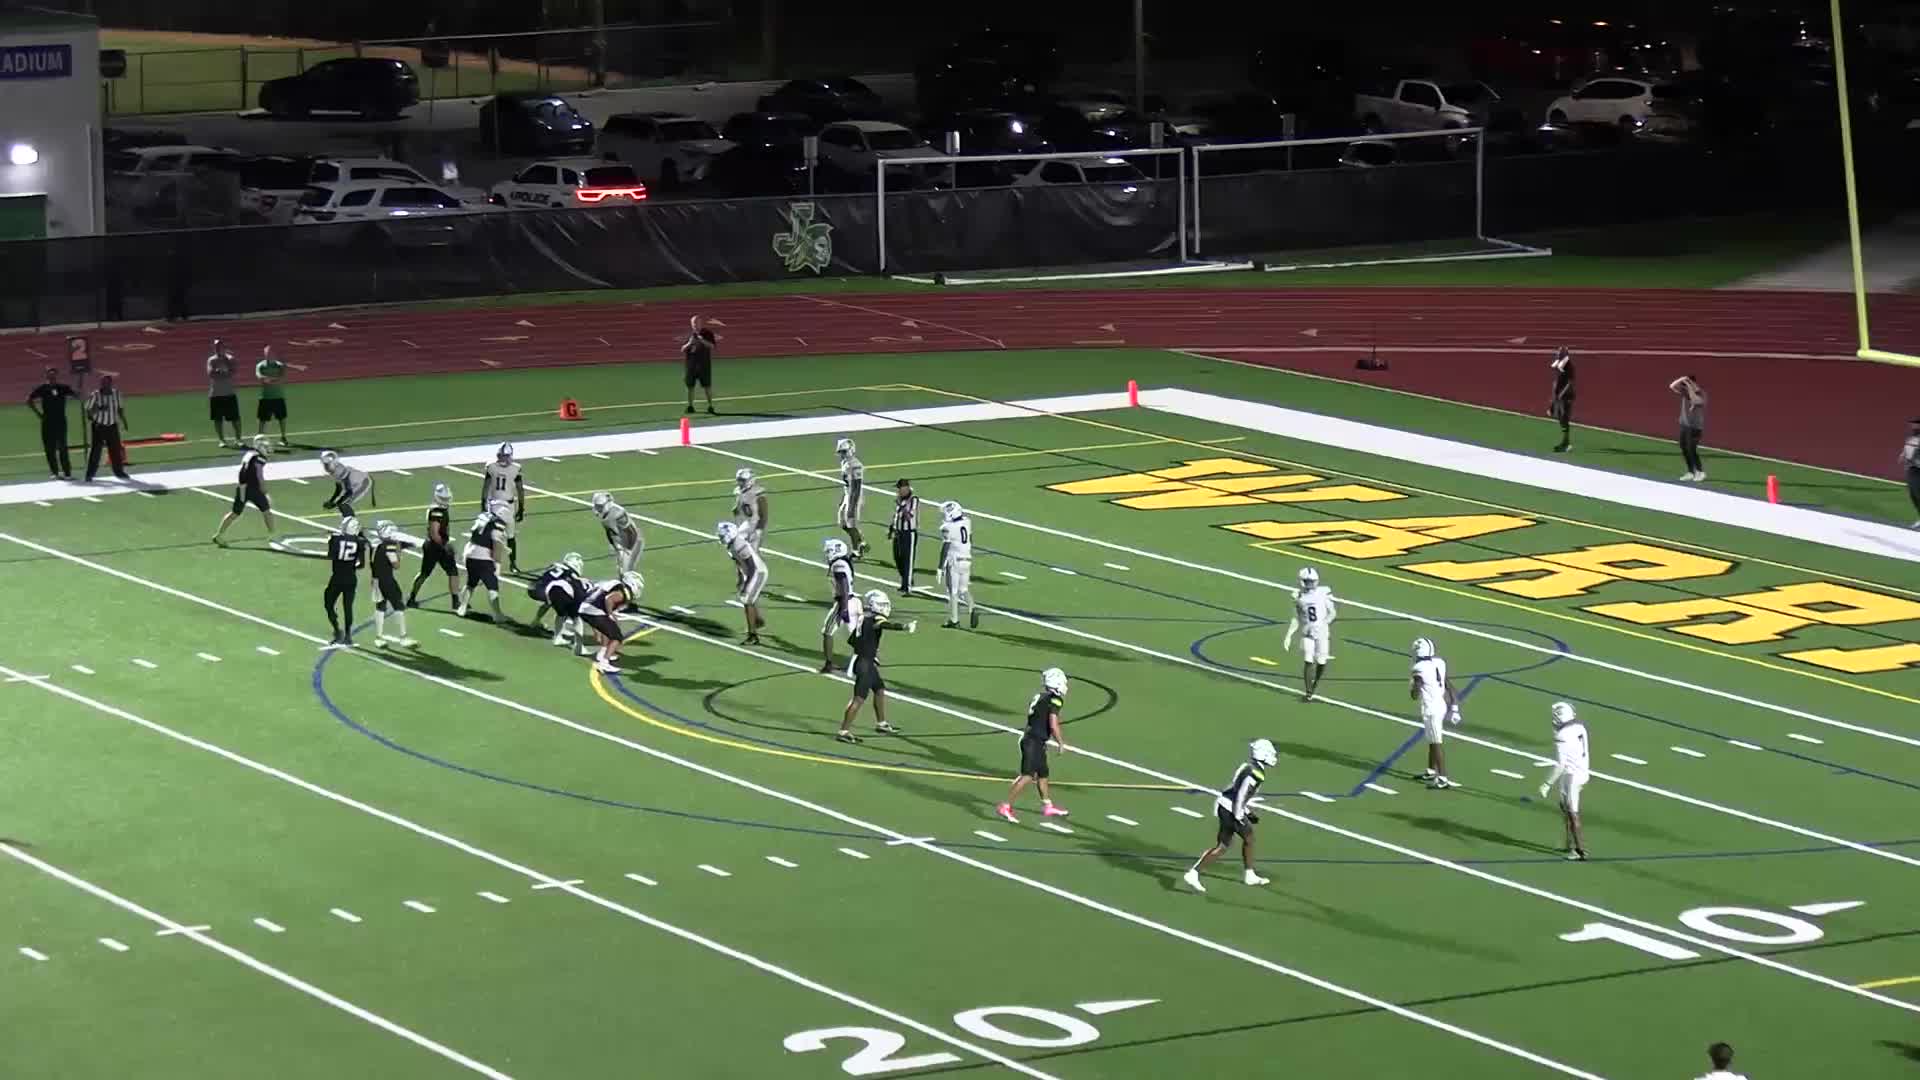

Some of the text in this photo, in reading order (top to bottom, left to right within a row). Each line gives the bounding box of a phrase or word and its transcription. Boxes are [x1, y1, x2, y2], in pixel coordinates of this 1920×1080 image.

[71, 338, 88, 361] 2
[566, 402, 578, 417] G
[496, 476, 507, 492] 11
[959, 525, 968, 545] 0
[338, 541, 358, 561] 12
[1307, 605, 1318, 622] 8
[1557, 905, 1825, 961] 10
[783, 1005, 1101, 1076] 20
